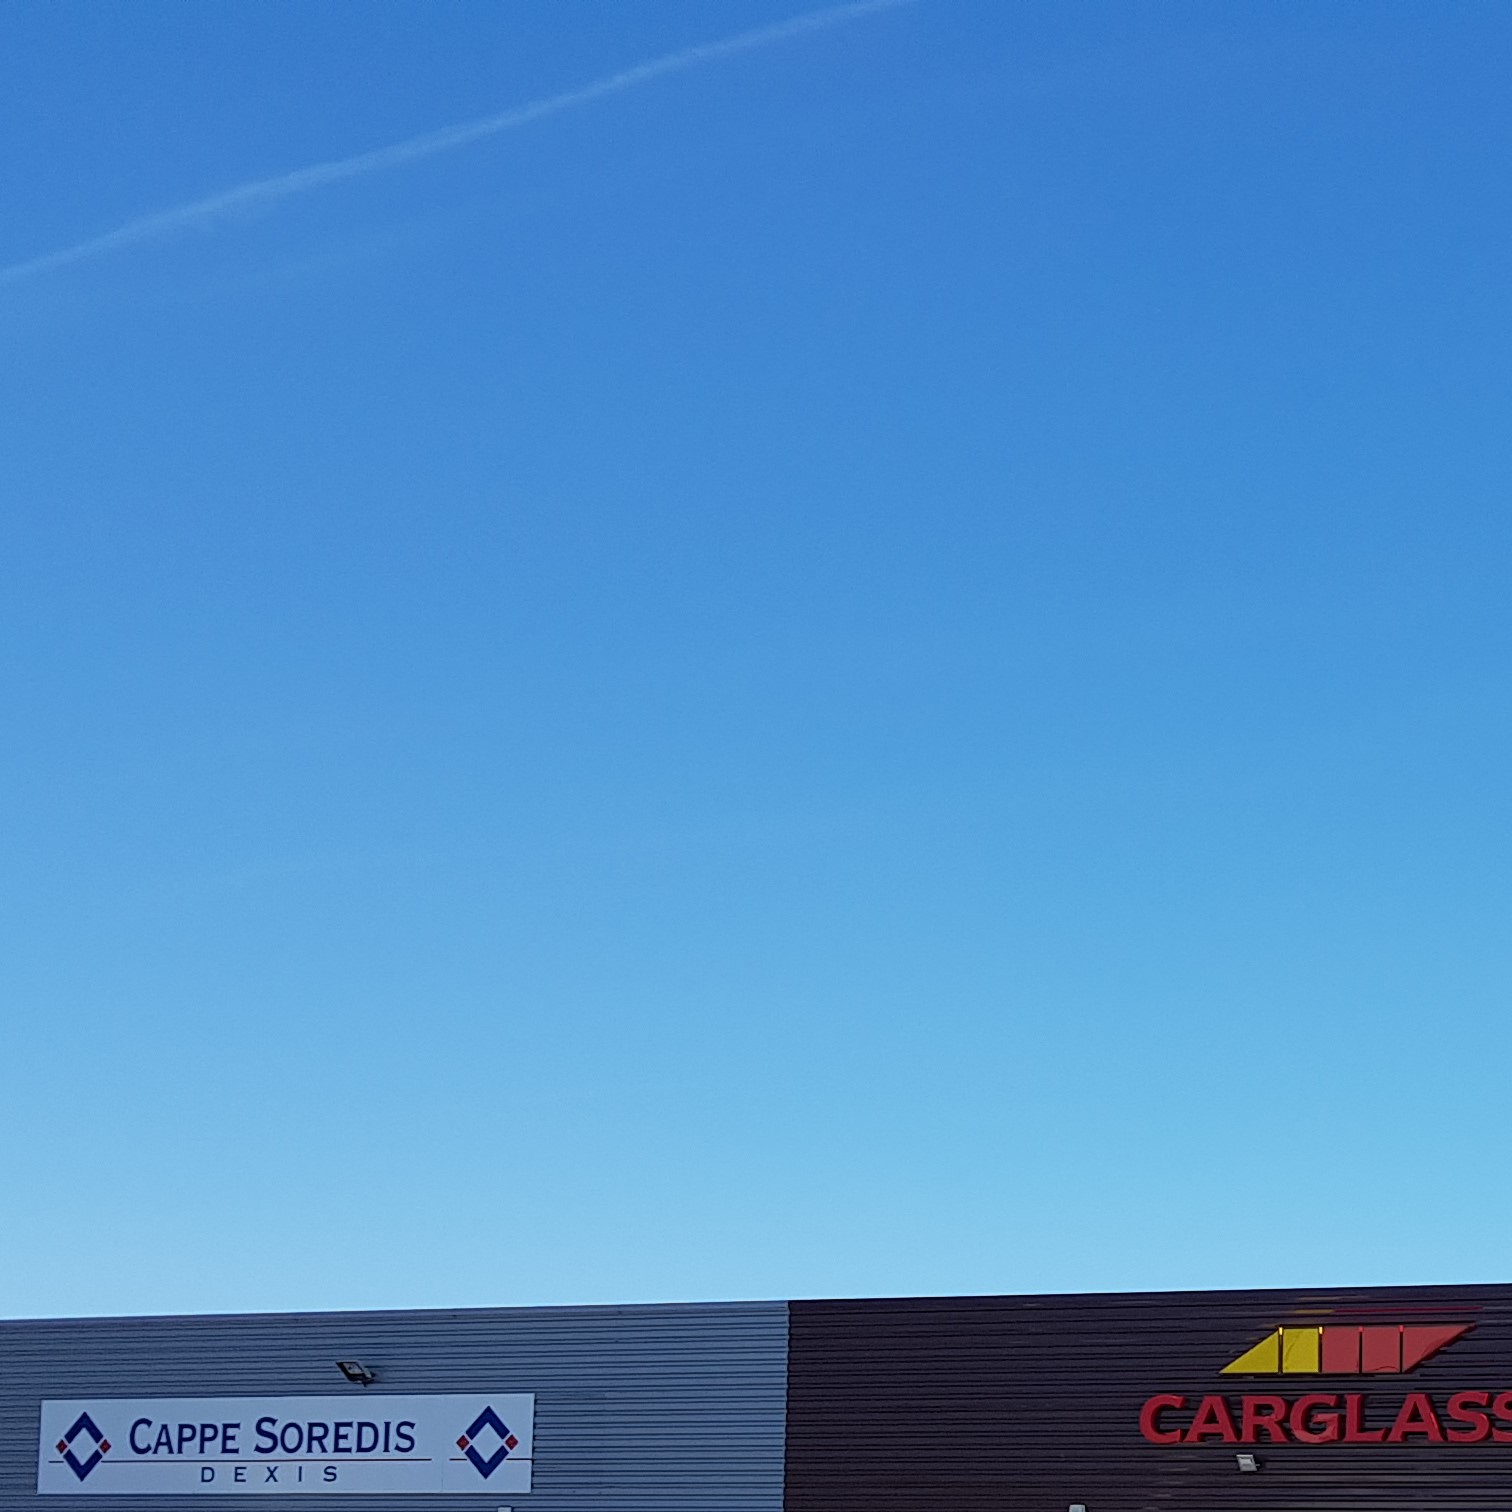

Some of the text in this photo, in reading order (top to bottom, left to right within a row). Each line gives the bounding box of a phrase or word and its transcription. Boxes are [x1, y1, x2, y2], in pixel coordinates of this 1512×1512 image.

[129, 1417, 416, 1455] CAPPE SOREDIS
[200, 1466, 338, 1483] DEXIS
